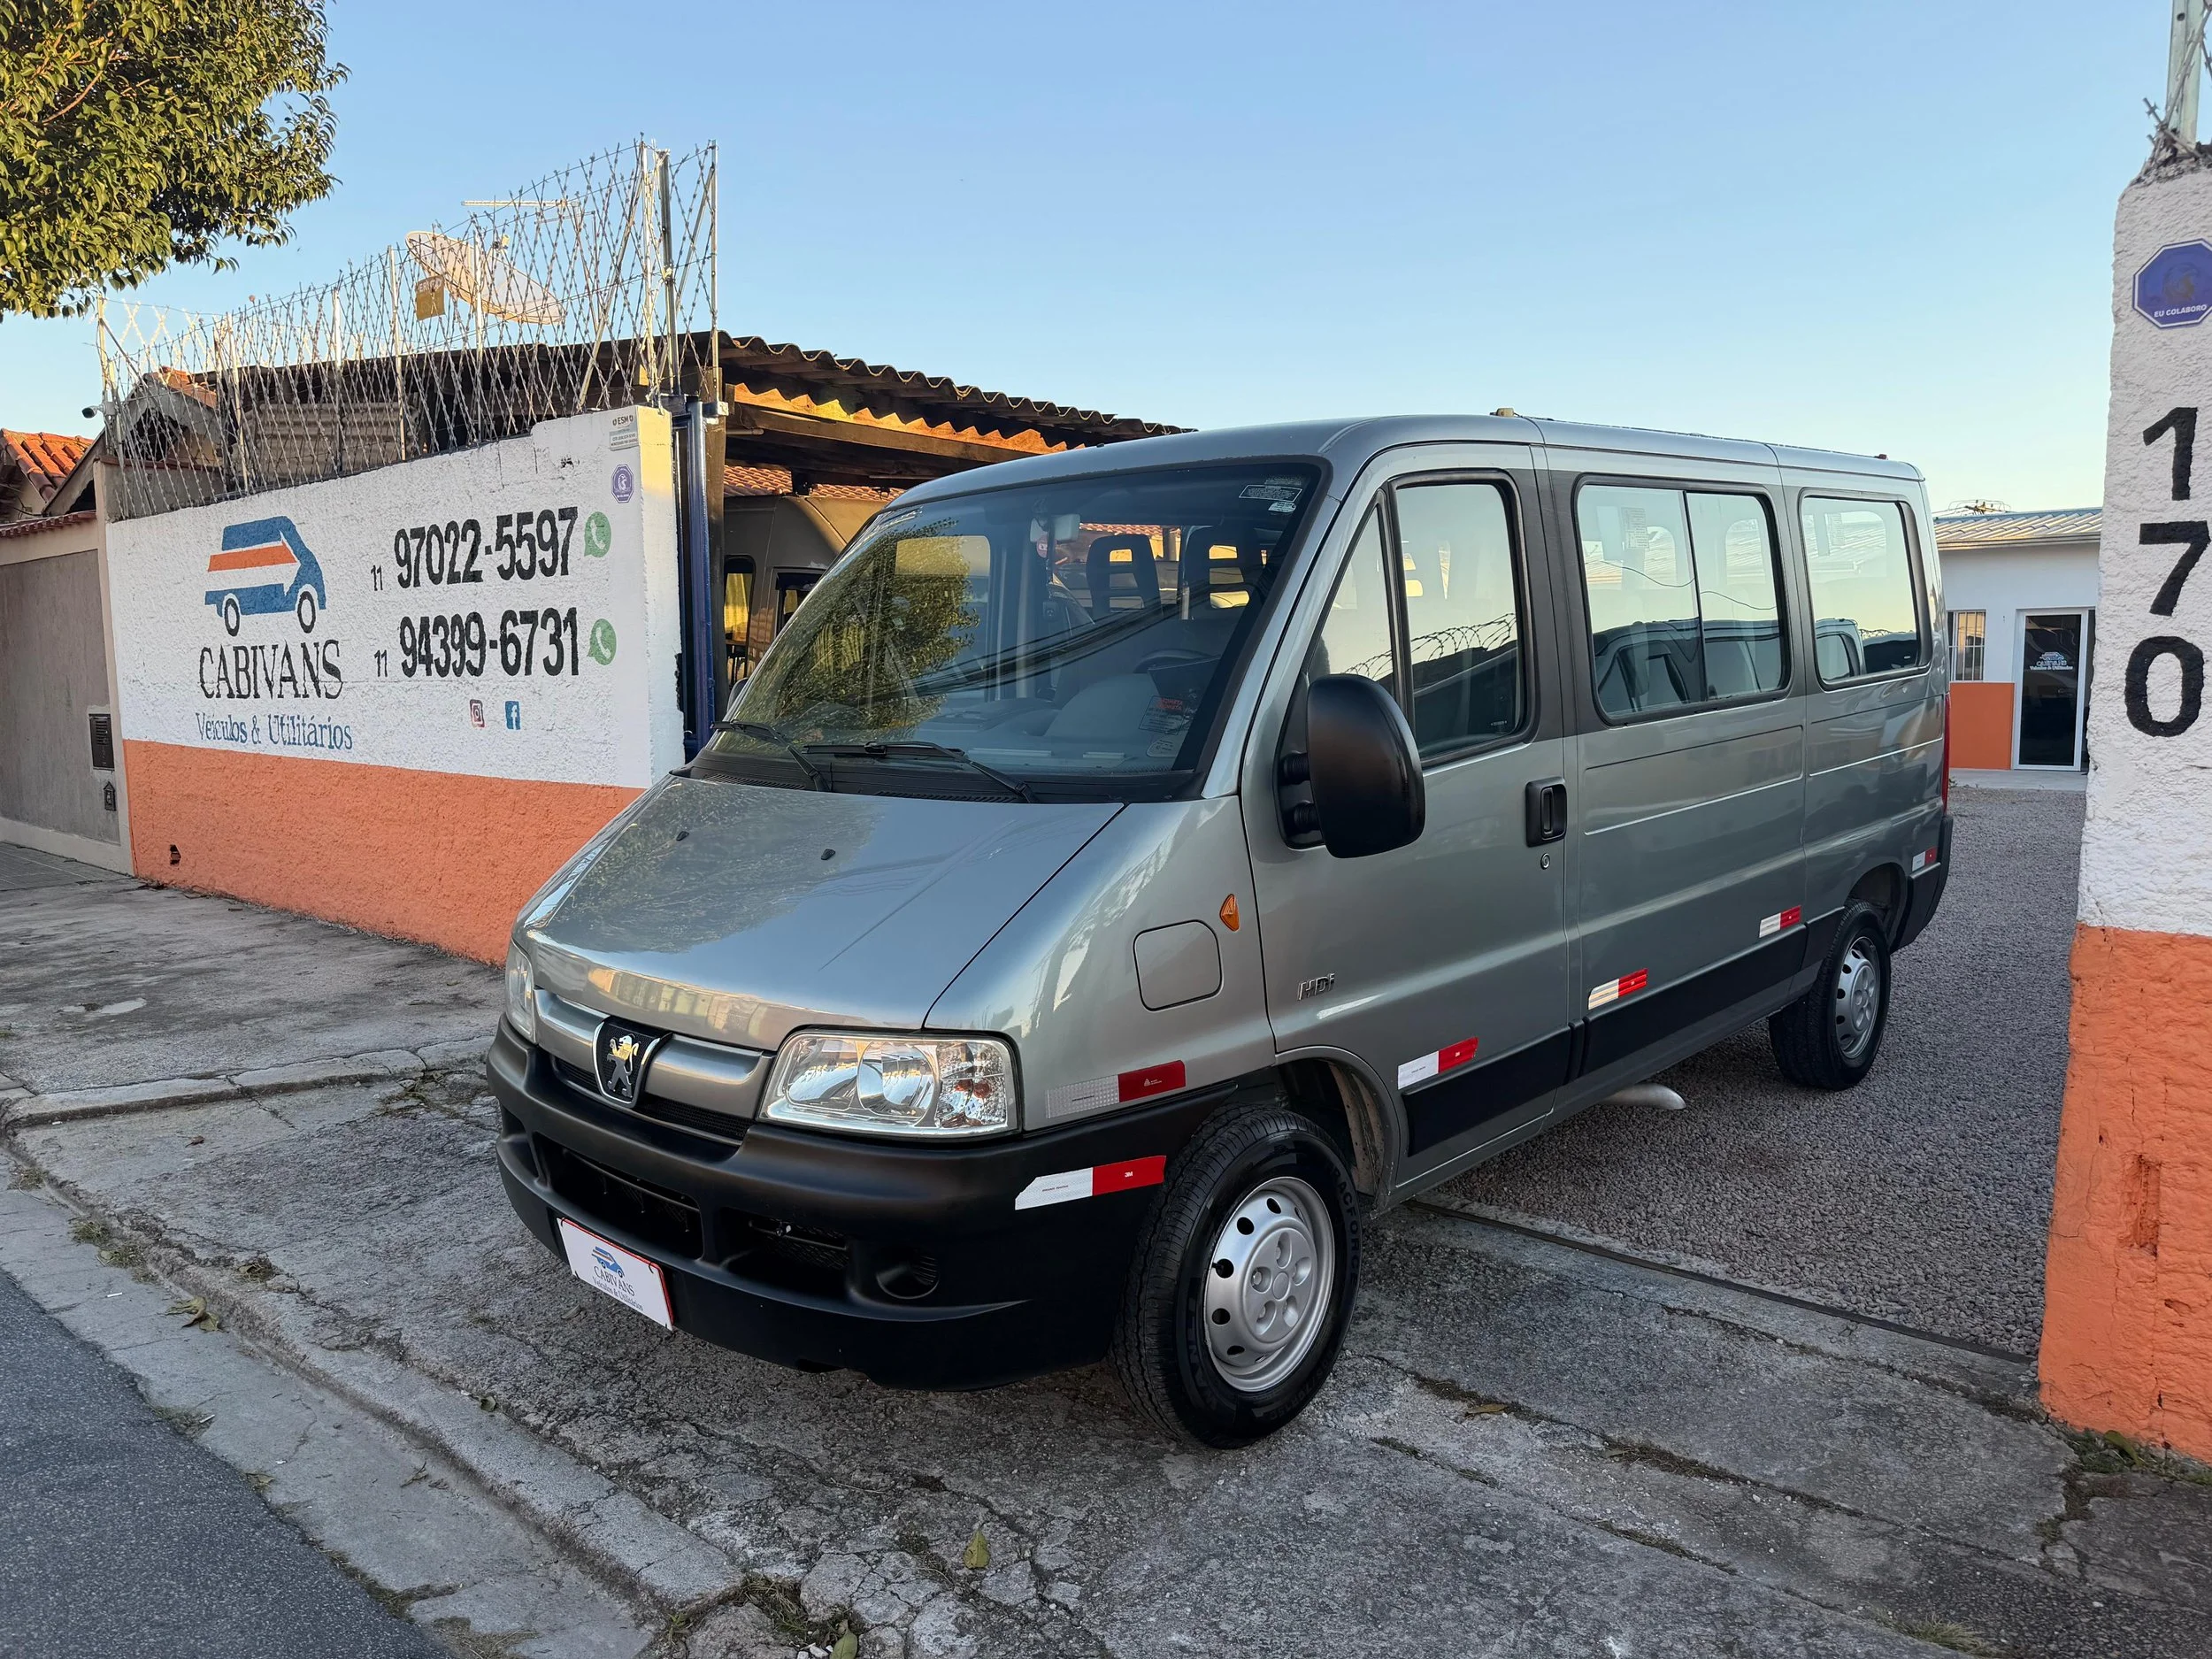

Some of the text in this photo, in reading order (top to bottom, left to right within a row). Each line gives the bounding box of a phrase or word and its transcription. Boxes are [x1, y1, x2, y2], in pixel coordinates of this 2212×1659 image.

[2166, 304, 2208, 316] COLABORO
[371, 506, 578, 591] 11 97022-5597
[2124, 407, 2211, 737] 170
[199, 639, 344, 700] CABIVANS
[373, 607, 579, 678] 11 94399-6731
[251, 715, 262, 744] &
[268, 714, 353, 750] Utilitários
[594, 1265, 635, 1297] CABIVANS
